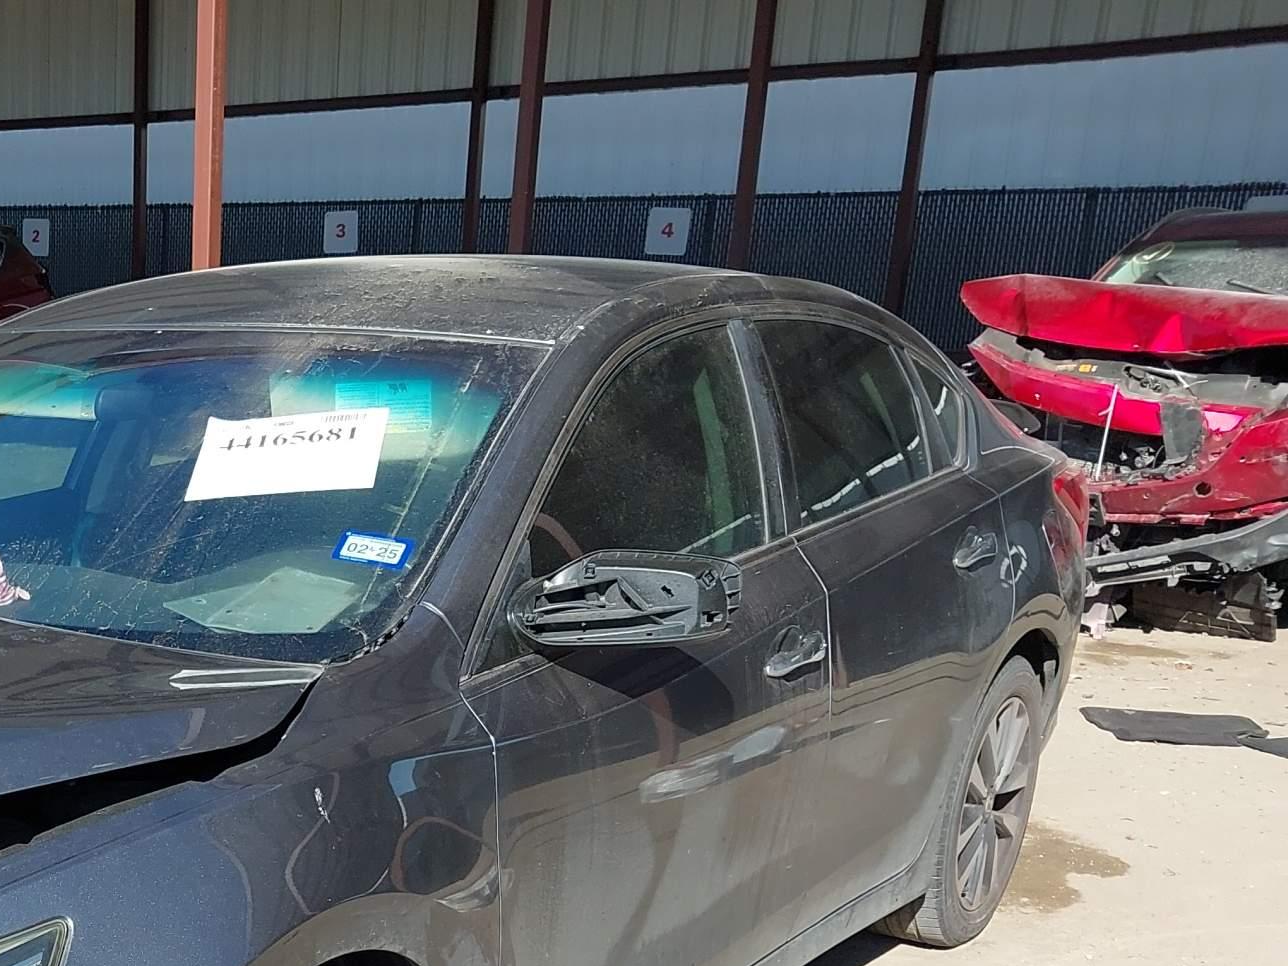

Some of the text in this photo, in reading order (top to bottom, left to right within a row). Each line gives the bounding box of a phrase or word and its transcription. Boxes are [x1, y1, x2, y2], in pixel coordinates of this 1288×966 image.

[31, 229, 41, 244] 2
[335, 223, 346, 239] 3
[660, 221, 675, 239] 4
[219, 427, 358, 451] 44165681
